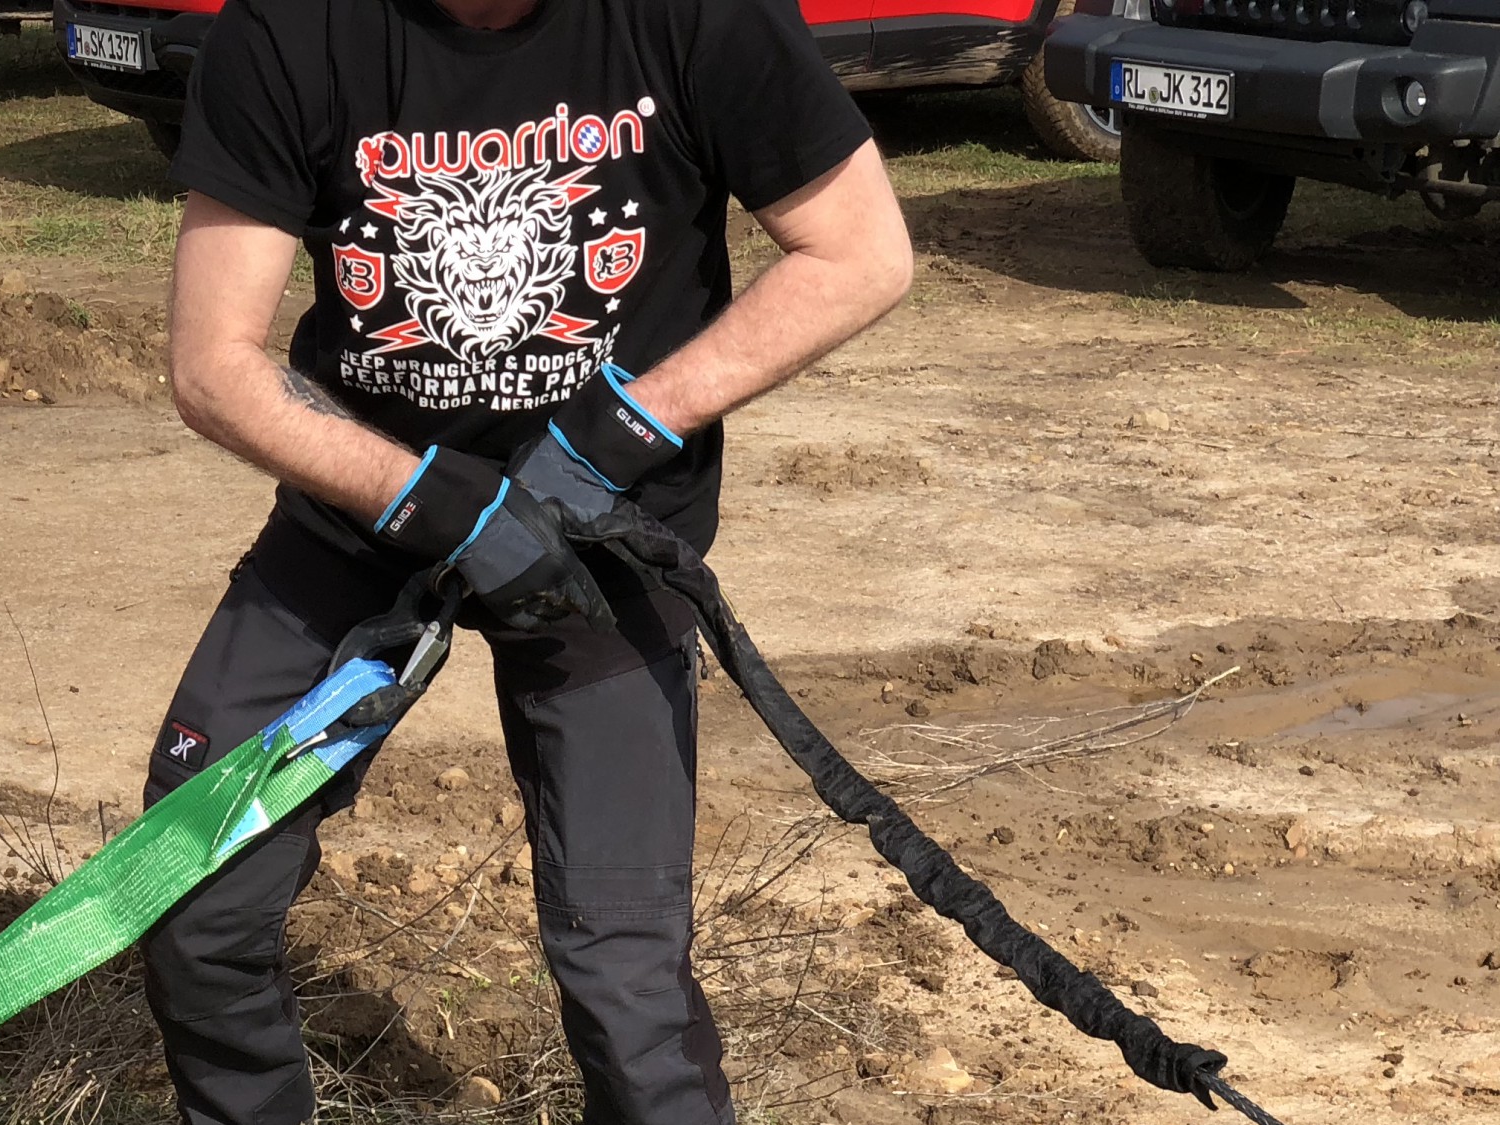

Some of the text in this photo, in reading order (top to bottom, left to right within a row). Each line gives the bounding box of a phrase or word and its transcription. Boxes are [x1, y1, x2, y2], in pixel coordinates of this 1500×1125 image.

[75, 28, 138, 63] H SK 1377
[1123, 67, 1228, 109] RL JK 312
[340, 348, 385, 371] JEEP
[392, 358, 497, 378] WRANGLER
[505, 354, 518, 371] &
[525, 346, 587, 373] DODGE
[340, 362, 533, 396] PERFORMANCE
[546, 338, 615, 392] PARTS
[419, 396, 472, 410] BLOOD
[490, 388, 570, 411] AMERICAN
[616, 407, 656, 444] GUIDE
[390, 501, 417, 531] GUIDE
